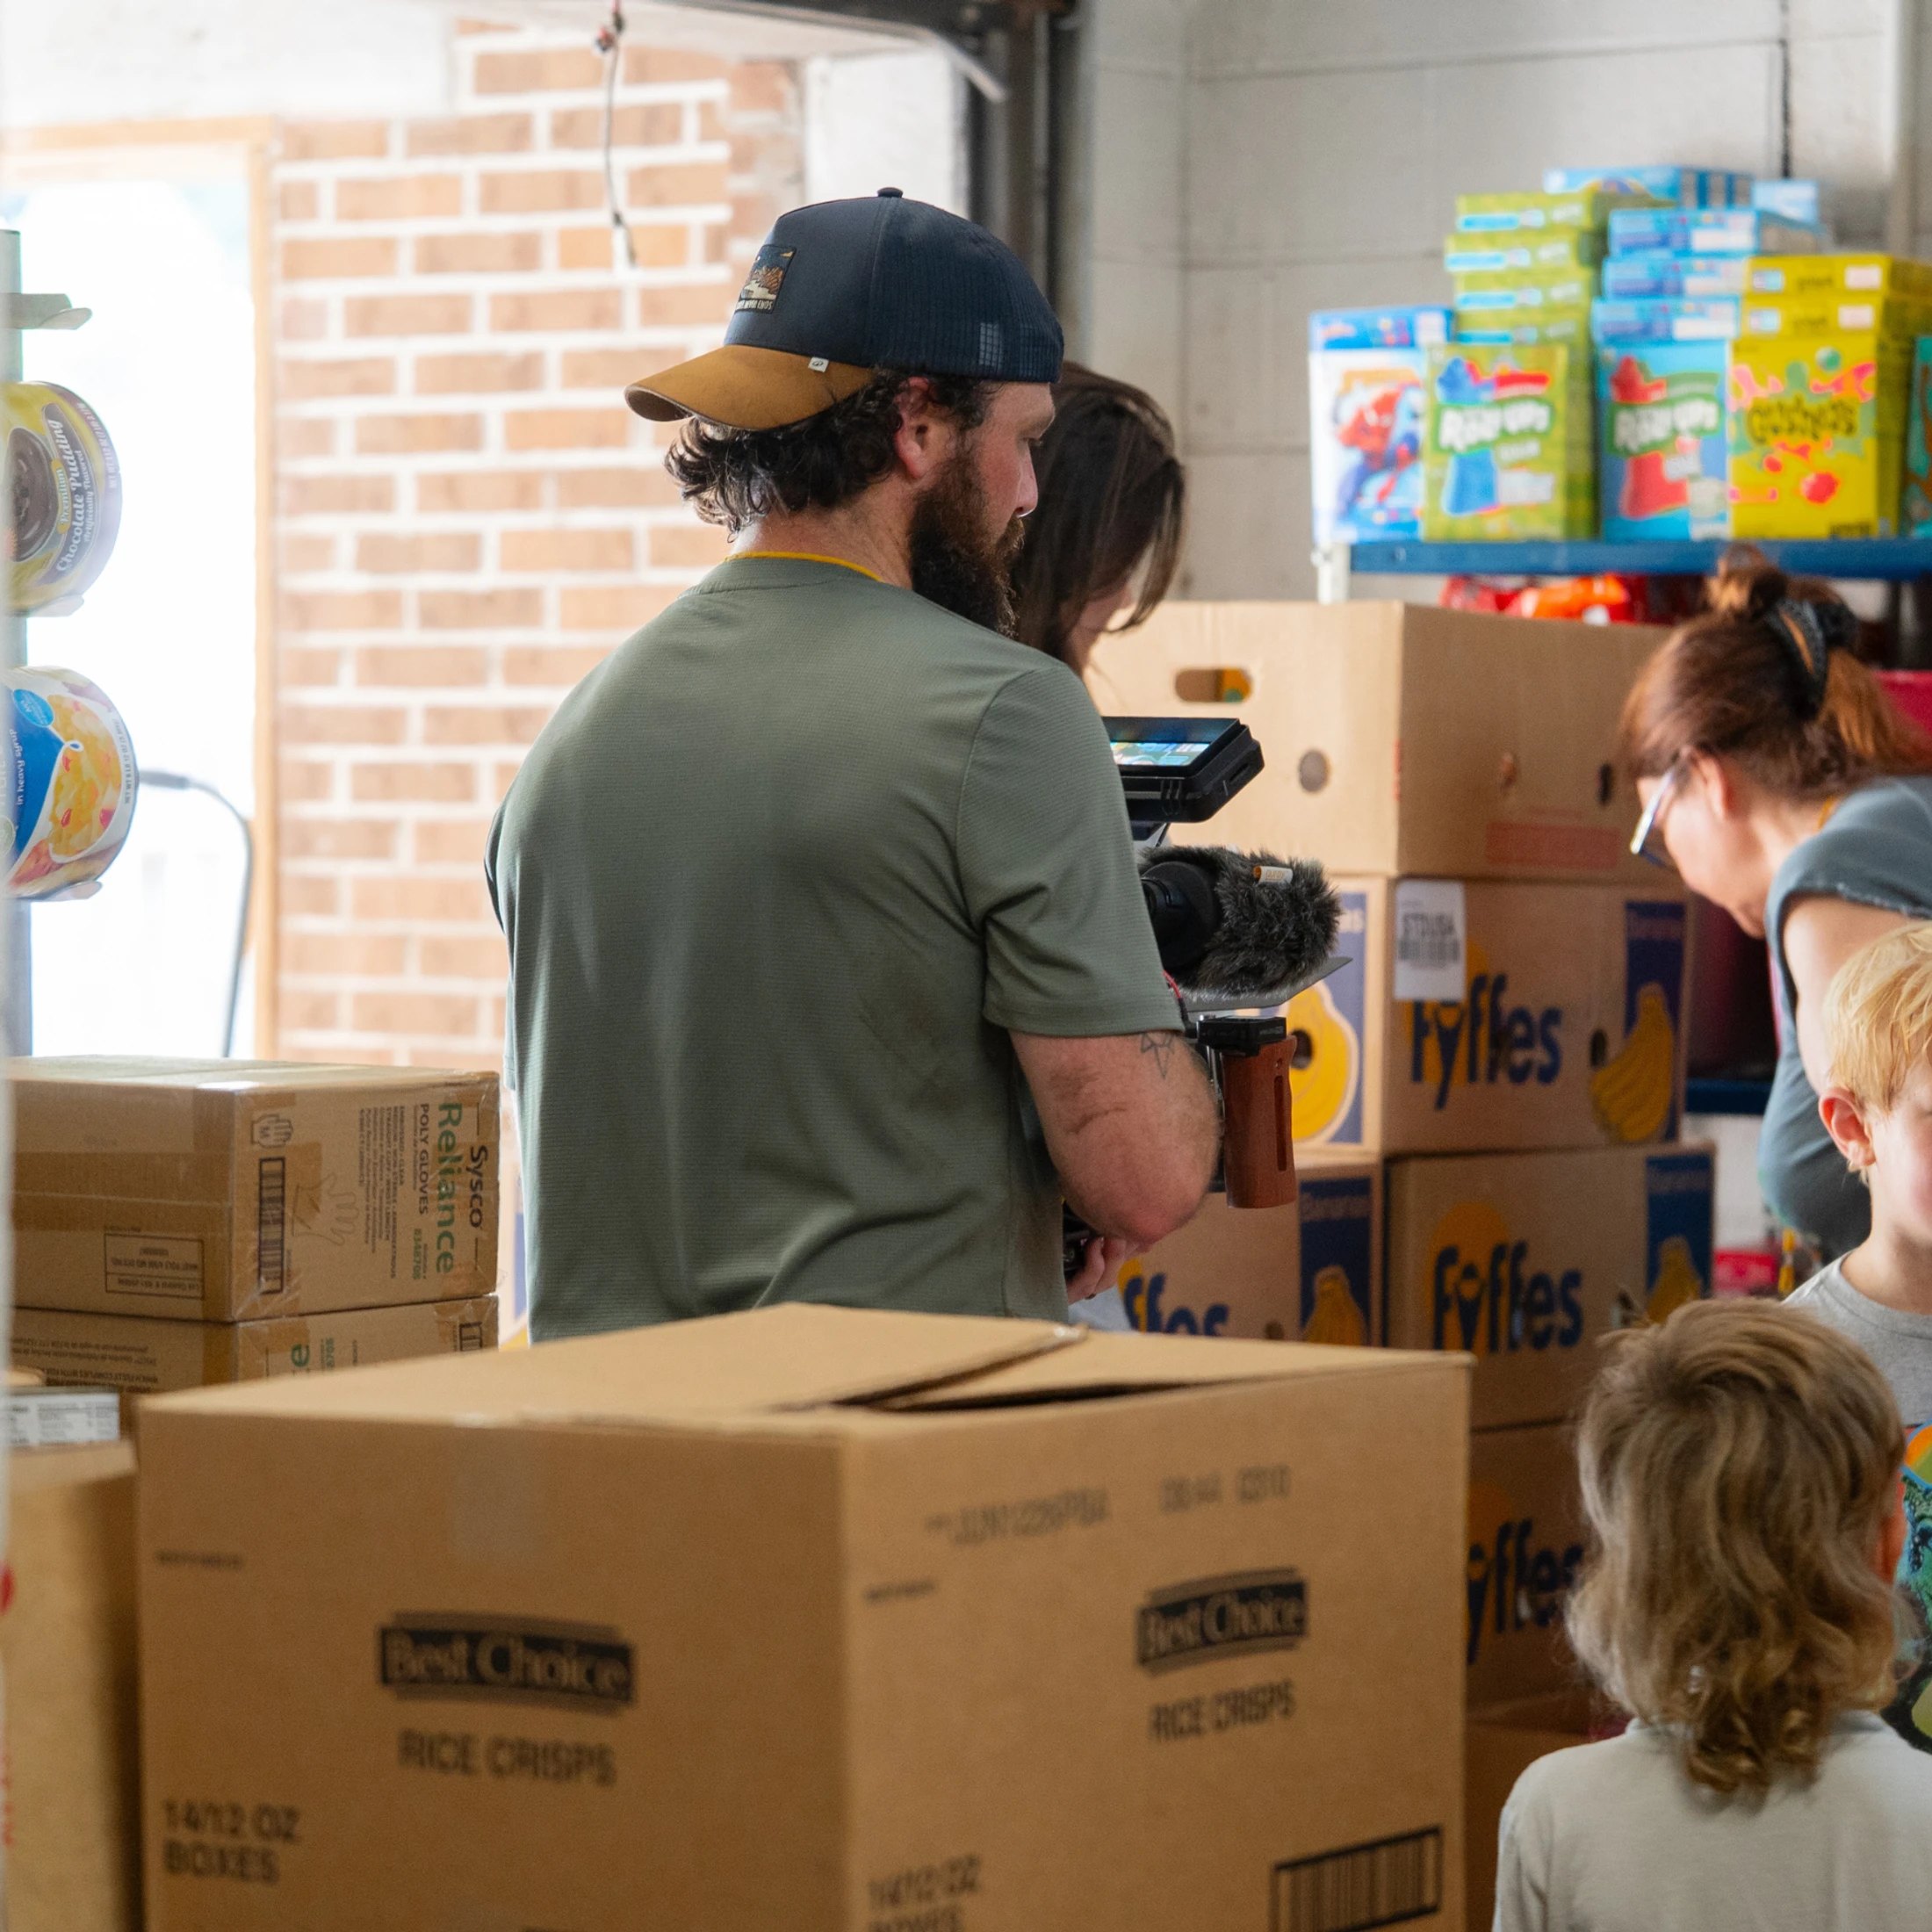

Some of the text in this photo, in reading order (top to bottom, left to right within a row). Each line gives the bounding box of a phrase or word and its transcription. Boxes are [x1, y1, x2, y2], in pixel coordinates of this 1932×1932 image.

[47, 419, 85, 571] Chocolate Pudding
[56, 468, 70, 525] Premium
[9, 729, 25, 806] in heavy syrup
[125, 780, 132, 789] WT
[1411, 973, 1563, 1111] fyffes
[419, 1104, 429, 1215] POLY GLOVES
[436, 1102, 463, 1274] Reliance
[466, 1144, 489, 1229] Sysco
[1435, 1239, 1583, 1354] fyffes
[1144, 1590, 1306, 1665] Best Choice
[384, 1632, 632, 1699] Best Choice
[1149, 1681, 1295, 1742] RICE CRISPS
[399, 1729, 616, 1787] RICE CRISPS
[252, 1803, 301, 1843] OZ
[162, 1837, 281, 1885] BOXES
